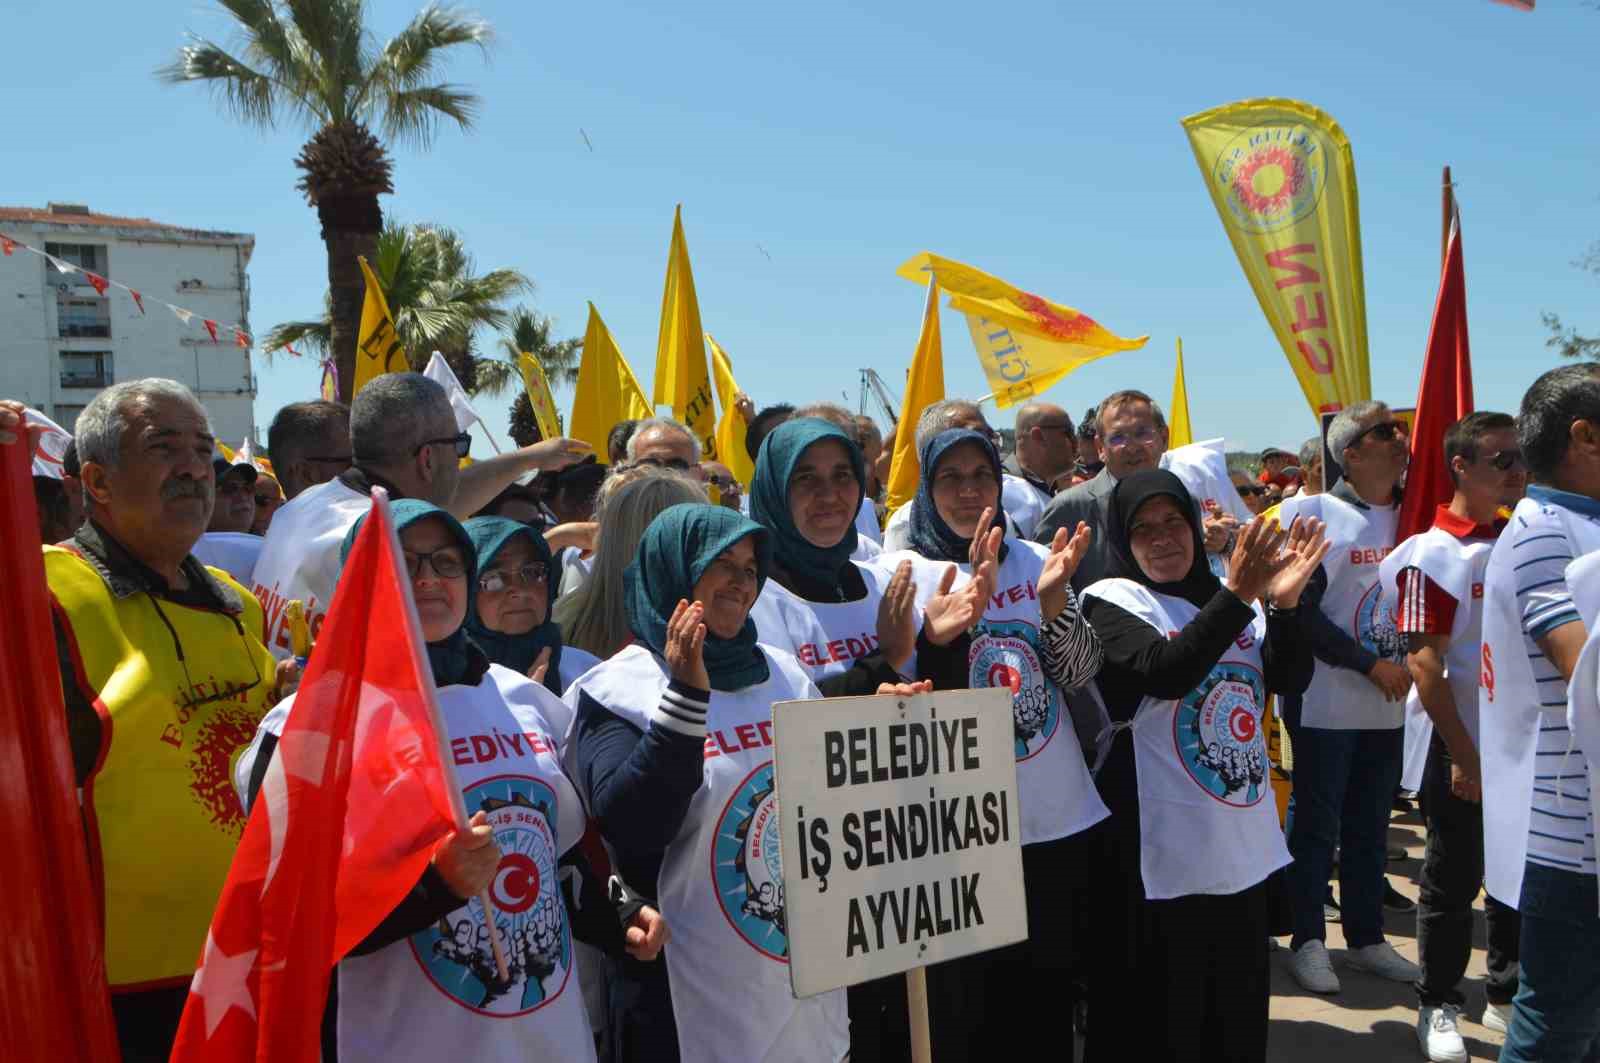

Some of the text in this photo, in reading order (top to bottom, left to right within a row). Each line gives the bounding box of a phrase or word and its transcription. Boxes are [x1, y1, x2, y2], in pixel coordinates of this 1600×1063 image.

[824, 707, 981, 789] BELEDİYE
[797, 786, 1010, 893] İŞ SENDİKASI
[846, 872, 985, 959] AYVALIK
